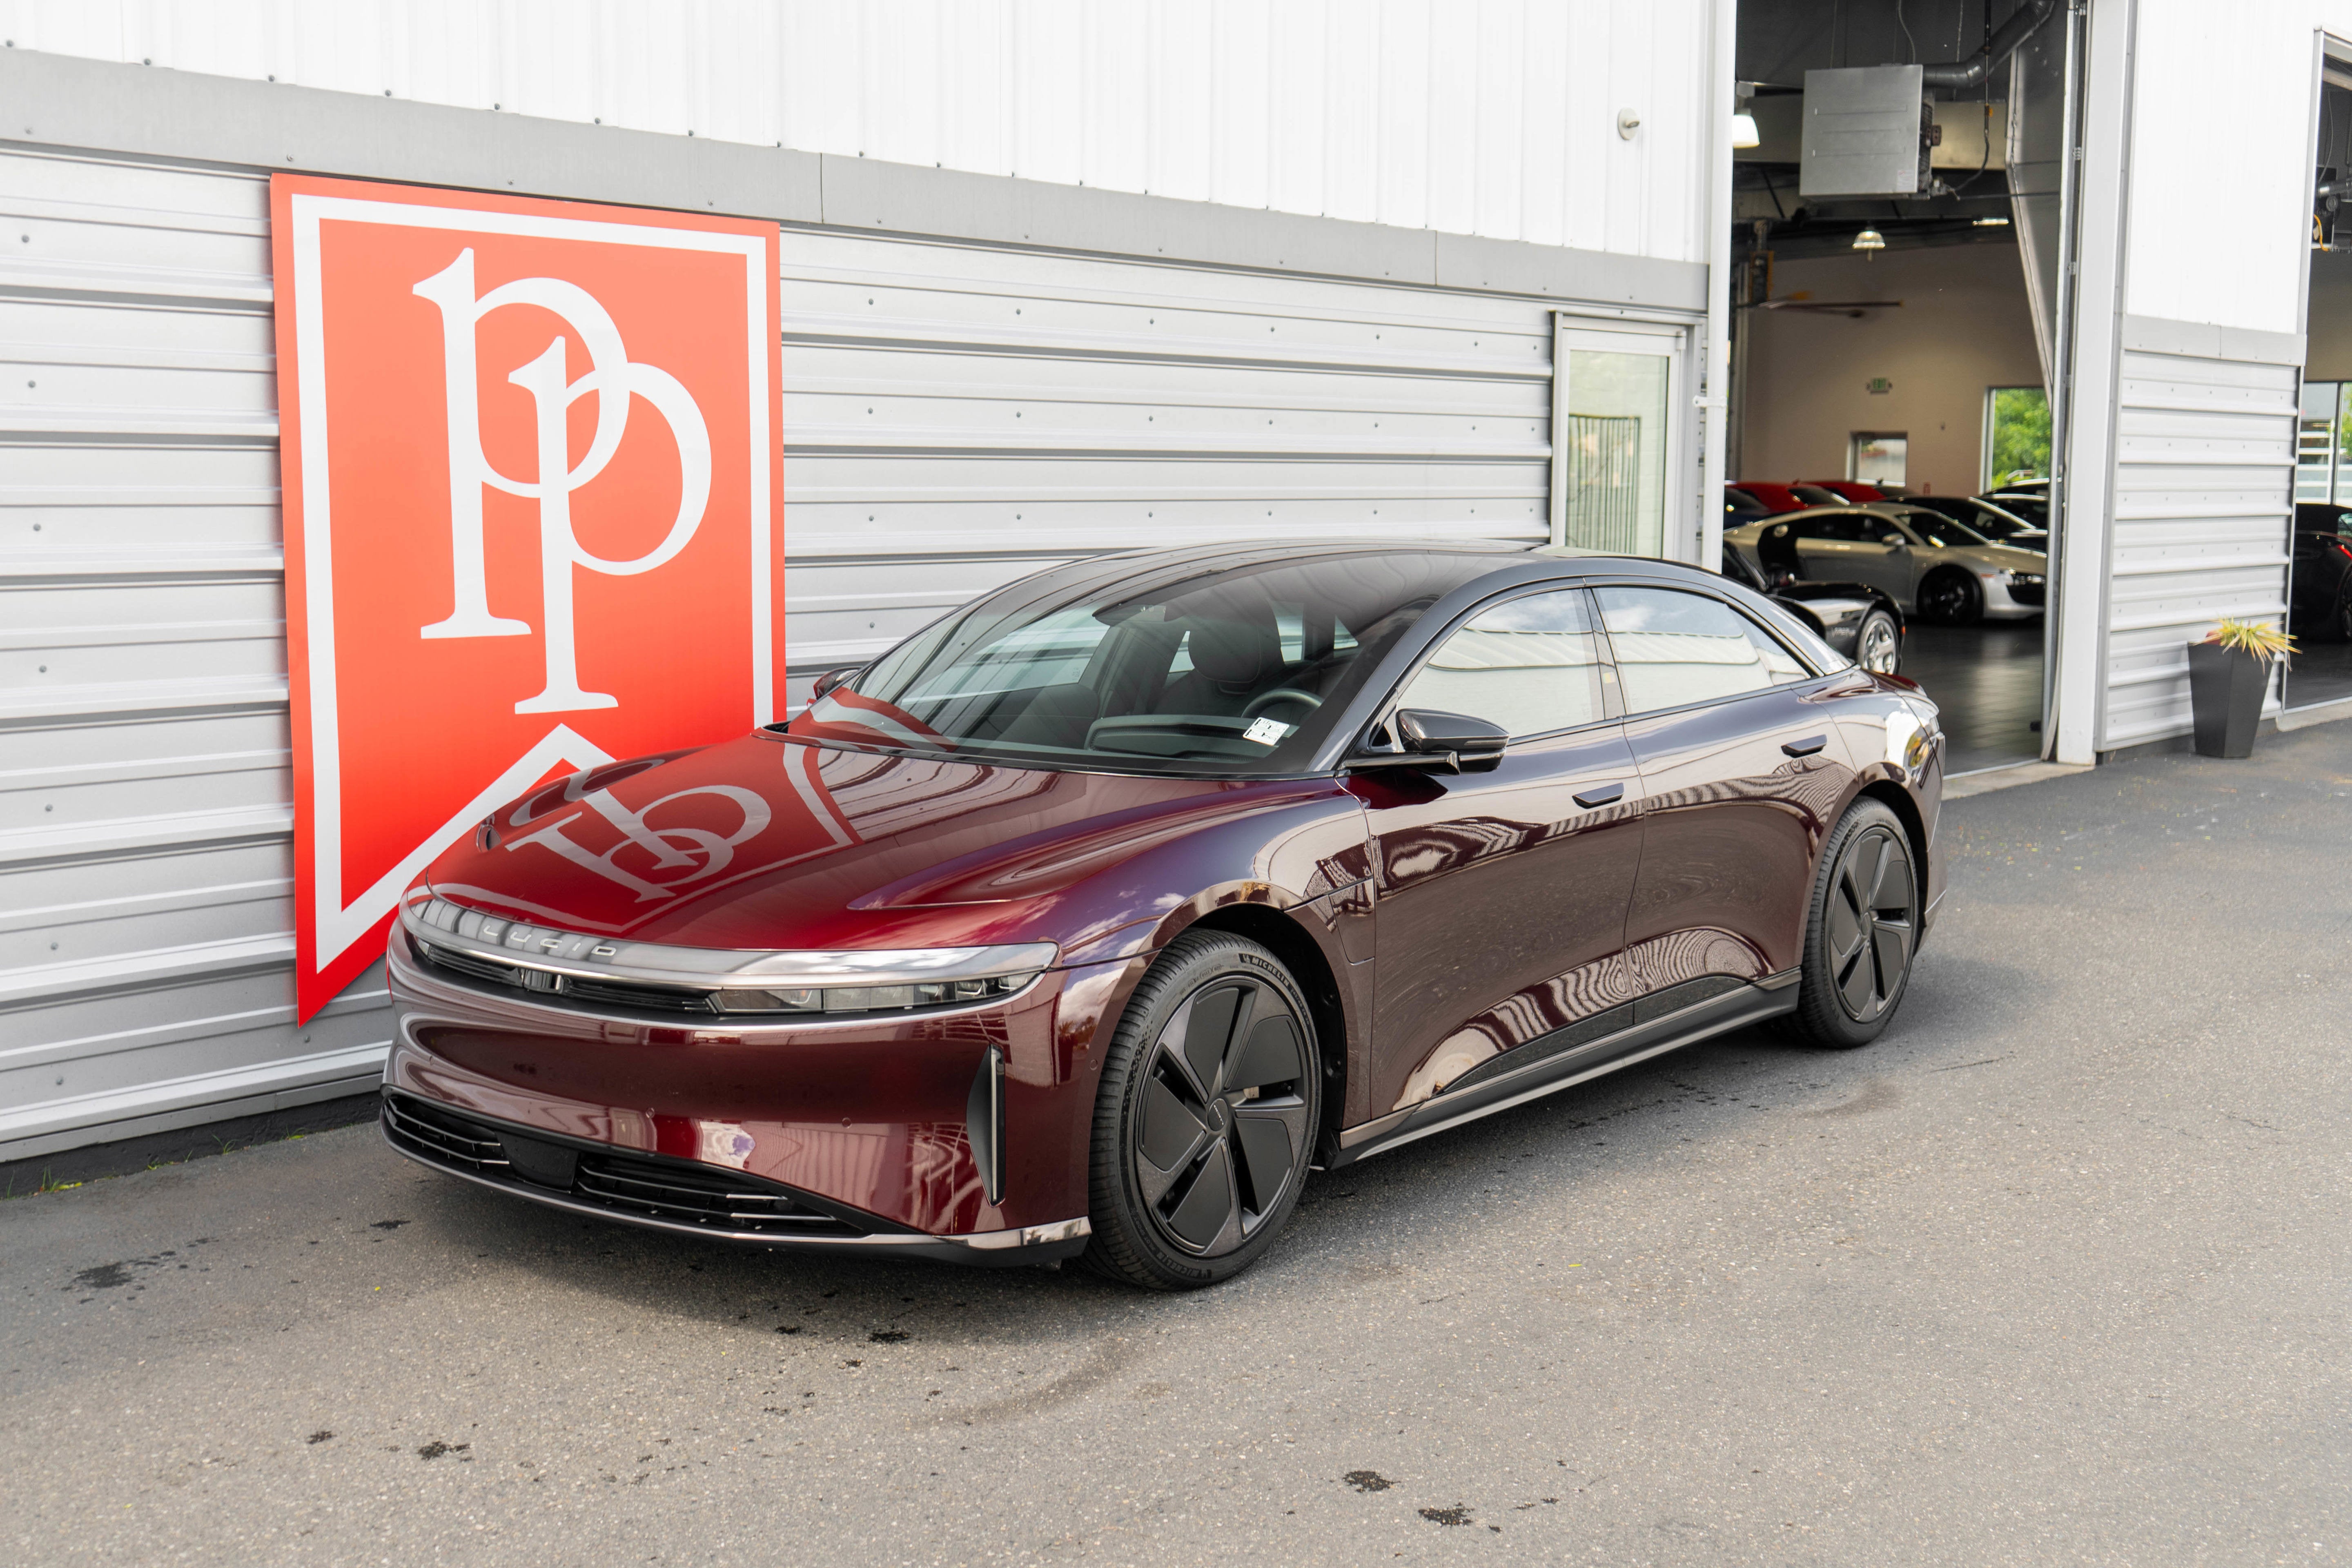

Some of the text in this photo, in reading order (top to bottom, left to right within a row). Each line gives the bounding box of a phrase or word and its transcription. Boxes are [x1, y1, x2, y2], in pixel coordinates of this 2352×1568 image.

[483, 925, 617, 956] LUCID
[1252, 956, 1290, 987] MICHELIN
[1156, 1251, 1200, 1278] MICHELIN
